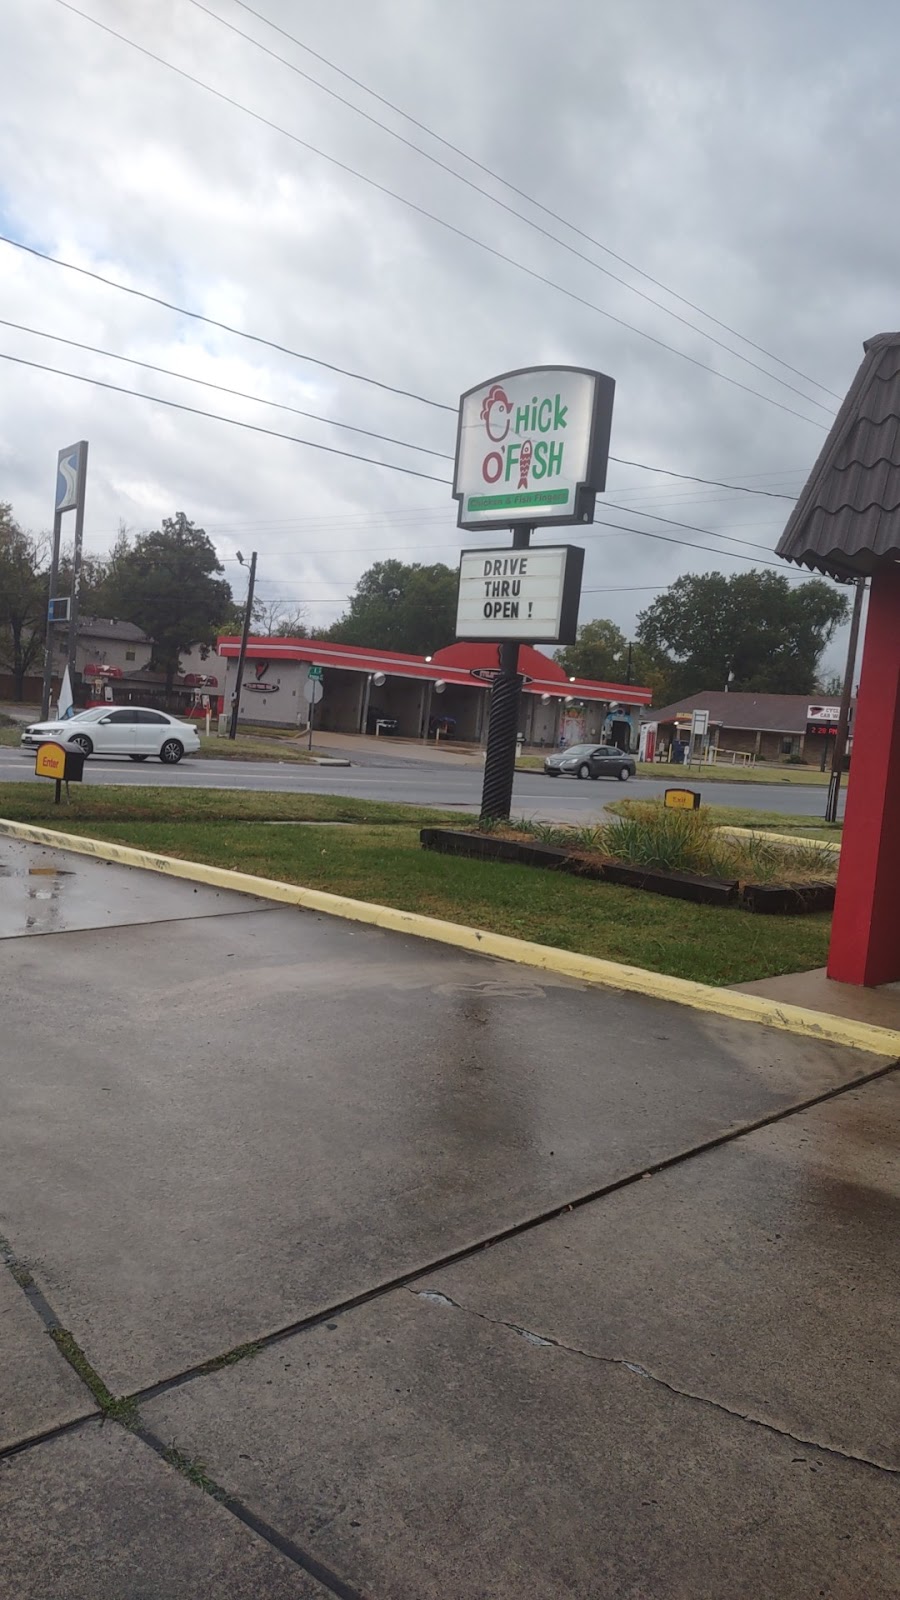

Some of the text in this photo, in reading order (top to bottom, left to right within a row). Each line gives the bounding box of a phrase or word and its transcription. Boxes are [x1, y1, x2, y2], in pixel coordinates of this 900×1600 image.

[484, 558, 528, 576] DRIVE
[485, 580, 521, 597] THRU
[484, 602, 519, 618] OPEN
[43, 757, 59, 768] Enter
